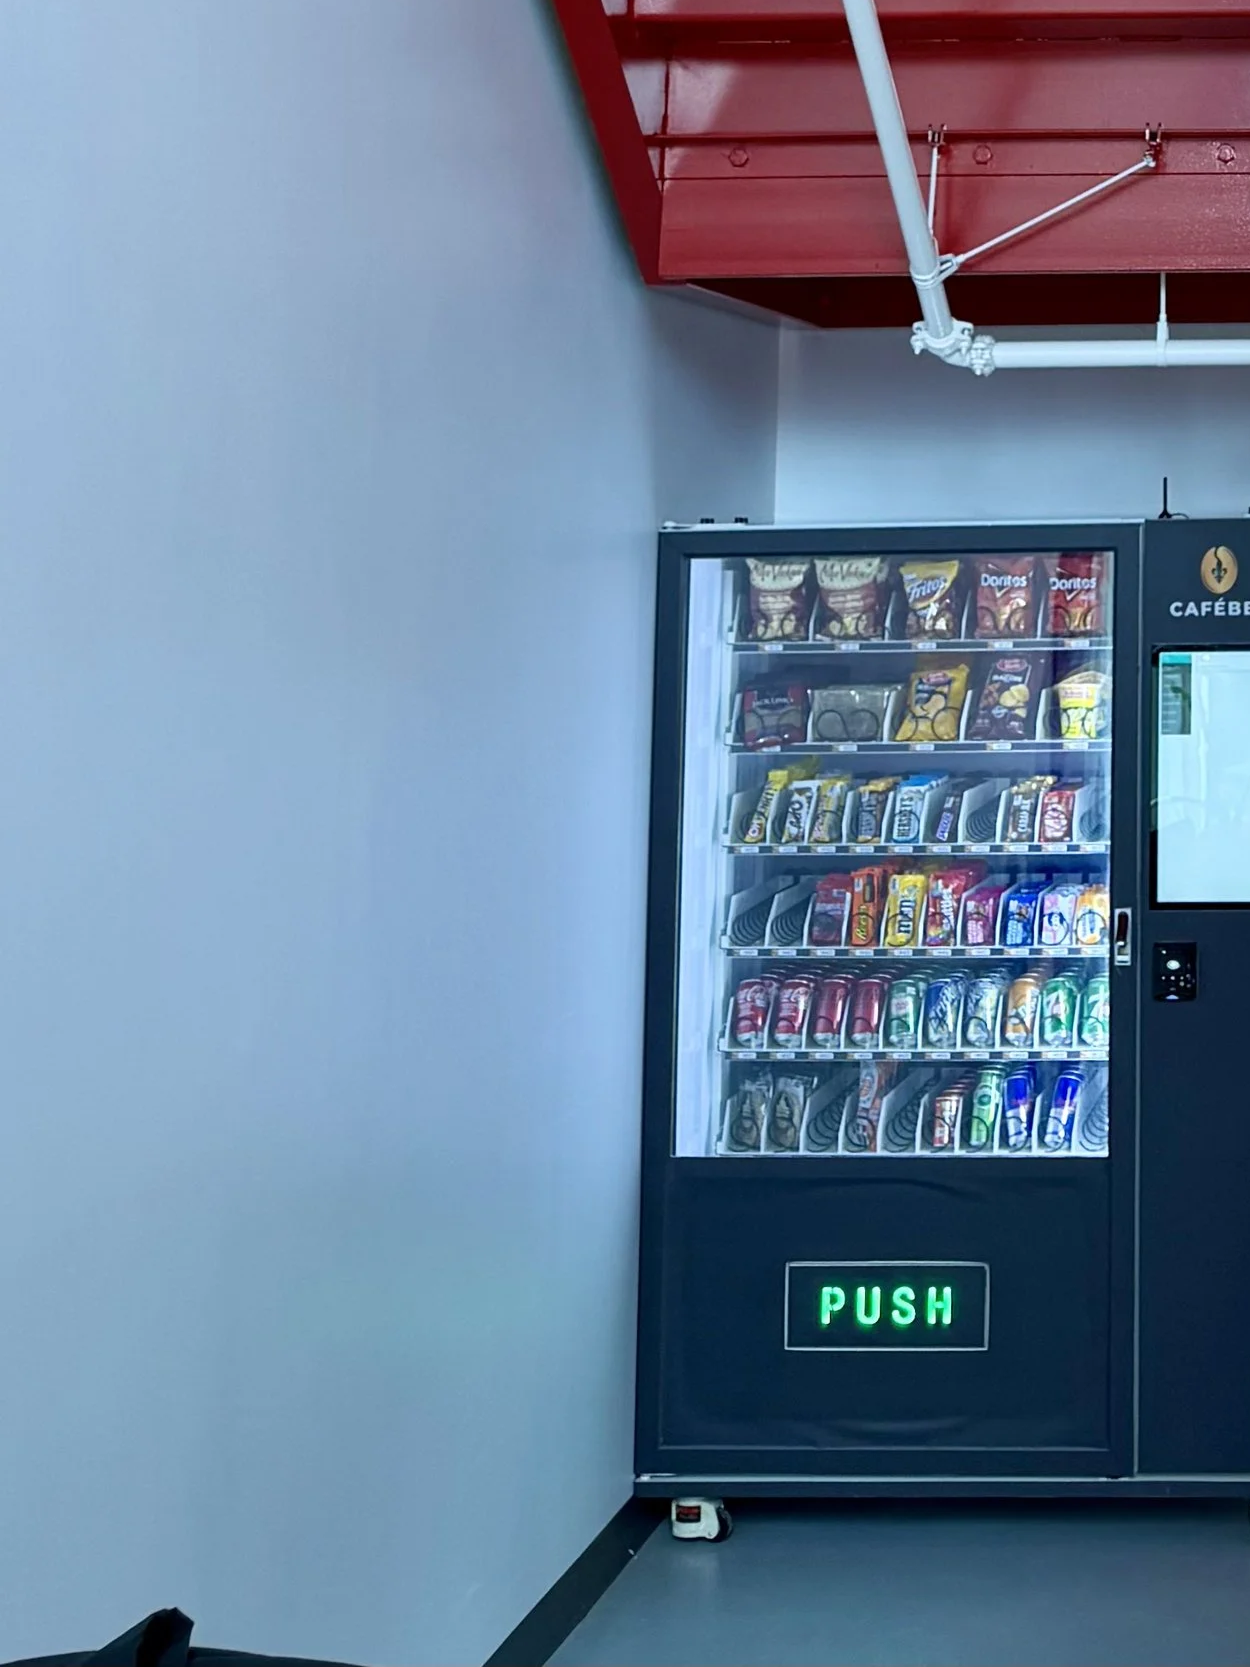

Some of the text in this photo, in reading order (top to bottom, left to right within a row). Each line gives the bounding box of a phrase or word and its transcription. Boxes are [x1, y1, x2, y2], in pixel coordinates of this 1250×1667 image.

[908, 576, 946, 603] Fritos
[981, 573, 1027, 588] Doritos
[1050, 577, 1097, 590] Doritos
[820, 1286, 952, 1325] PUSH
